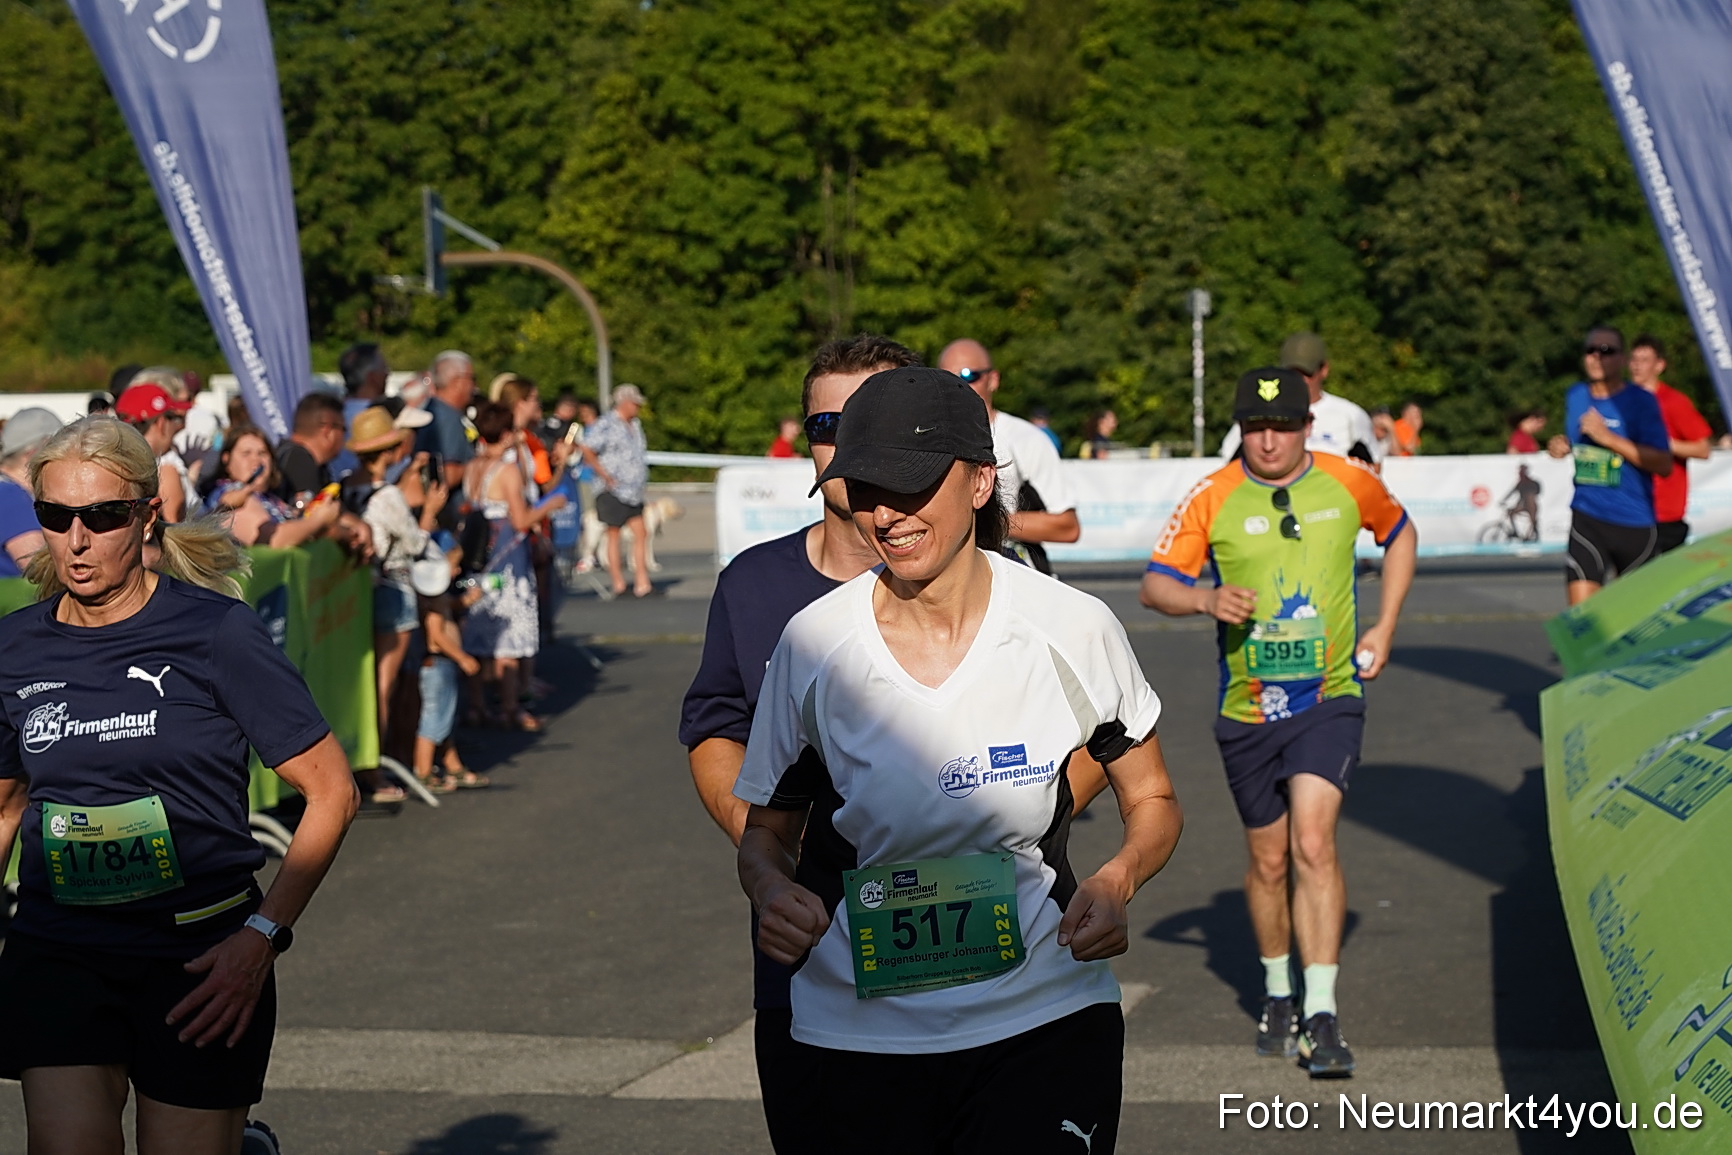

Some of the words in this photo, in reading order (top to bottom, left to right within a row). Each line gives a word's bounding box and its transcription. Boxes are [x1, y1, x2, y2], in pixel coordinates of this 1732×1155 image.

[1264, 640, 1307, 660] 595
[64, 709, 158, 737] Firmenlauf
[99, 725, 157, 743] neumarkt
[994, 751, 1025, 763] Fischer
[982, 760, 1055, 785] Firmenlauf
[1012, 772, 1055, 788] neumarkt
[68, 823, 104, 836] Firmenlauf
[50, 850, 65, 885] RUN
[62, 840, 151, 875] 1784
[151, 837, 174, 880] 2022
[68, 874, 112, 889] Spicker
[115, 869, 155, 888] Sylvia
[887, 881, 938, 899] Firmenlauf
[907, 891, 938, 902] neumarkt
[892, 900, 973, 951] 517
[993, 902, 1015, 961] 2022
[859, 927, 877, 972] RUN
[876, 950, 950, 968] Regensburger
[952, 944, 999, 958] Johanna
